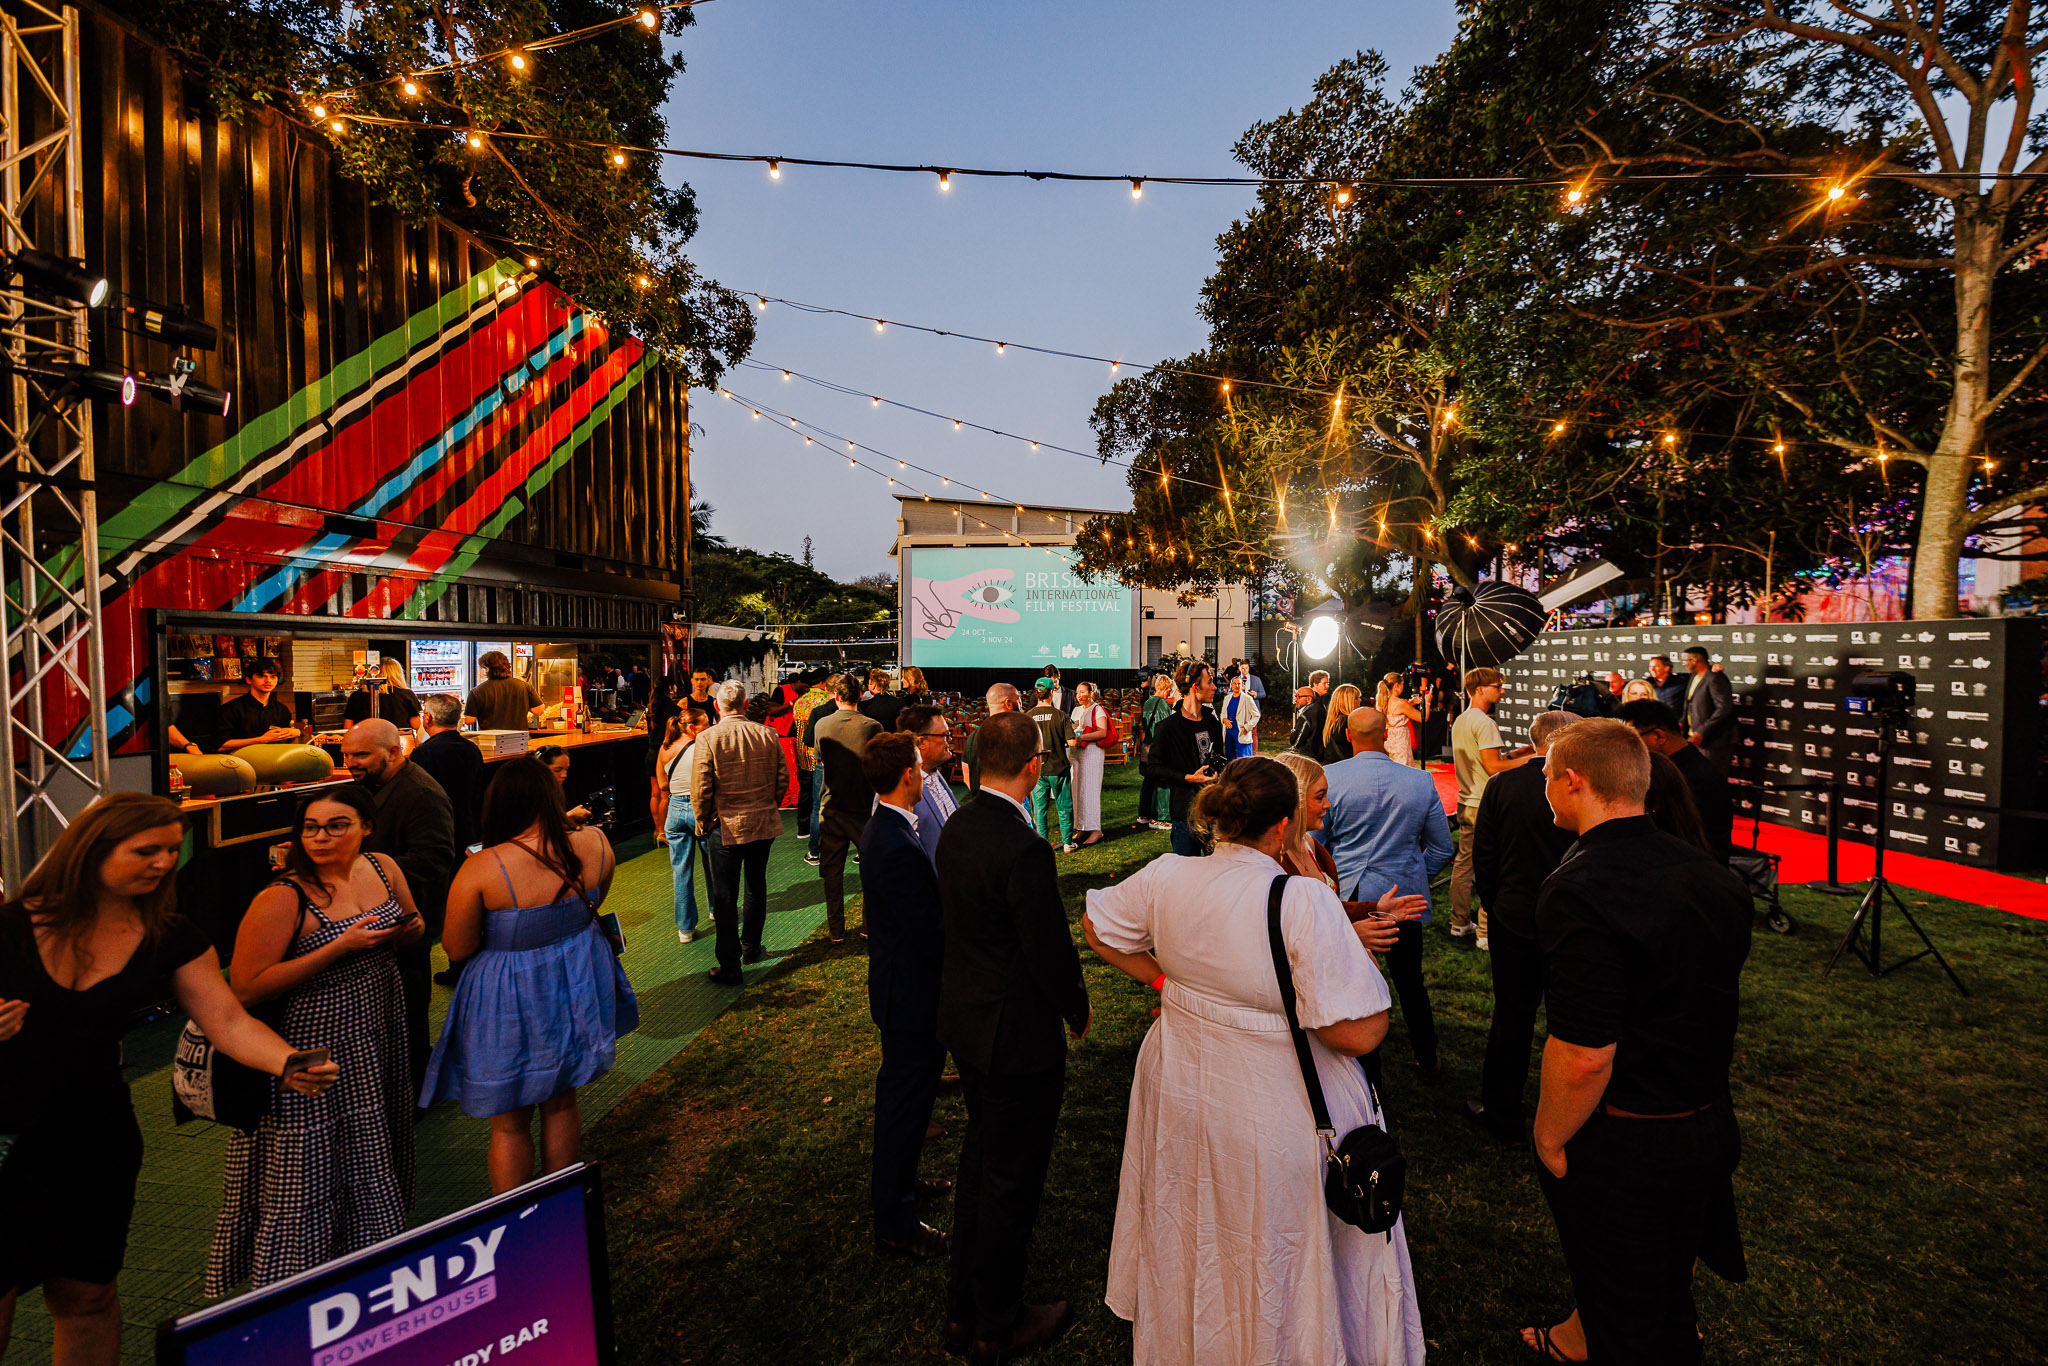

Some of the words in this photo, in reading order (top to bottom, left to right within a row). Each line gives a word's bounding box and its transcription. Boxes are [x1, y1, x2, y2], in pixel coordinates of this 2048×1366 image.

[1026, 589, 1121, 600] INTERNATIONAL
[1026, 601, 1055, 612] FILM
[1061, 601, 1121, 612] FESTIVAL
[309, 1225, 507, 1349] DENDY
[321, 1283, 490, 1366] POWERHOUSE
[500, 1318, 549, 1355] BAR
